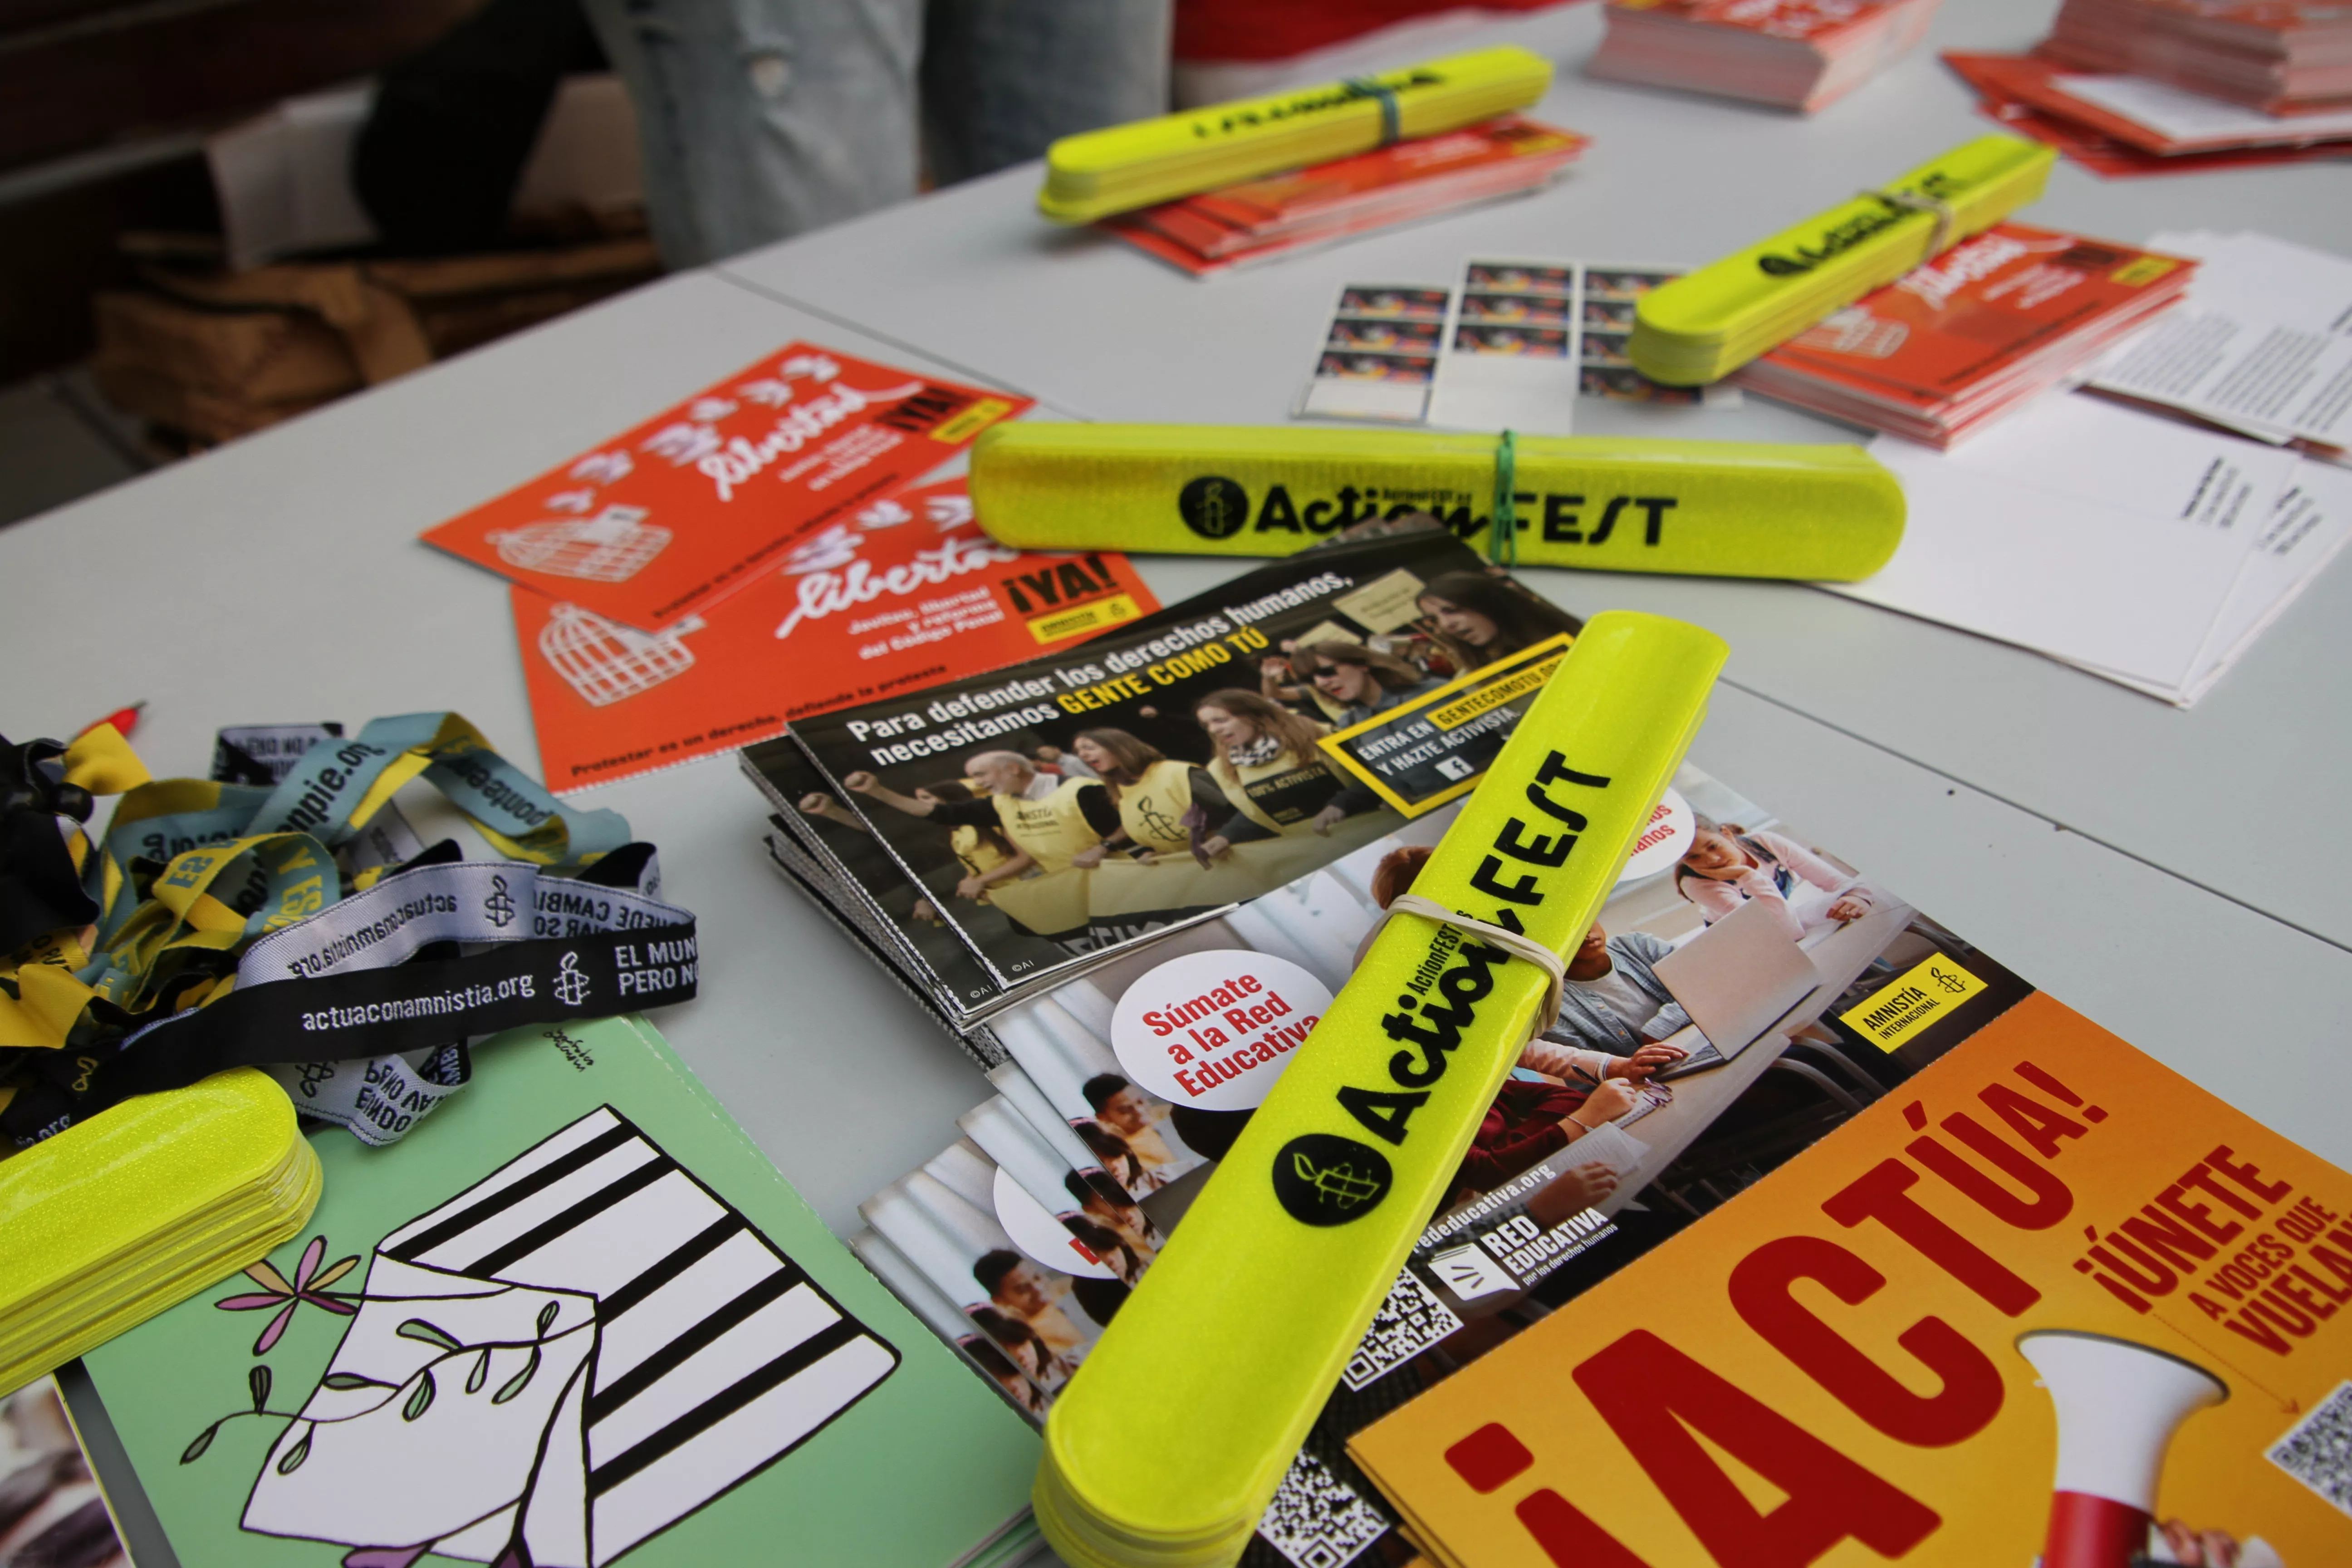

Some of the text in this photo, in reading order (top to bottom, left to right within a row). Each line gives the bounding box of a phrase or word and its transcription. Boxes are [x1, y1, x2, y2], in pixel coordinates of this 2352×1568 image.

[775, 536, 1021, 639] liberta
[1002, 555, 1118, 612] ¡YA!
[846, 711, 927, 743] Para
[926, 678, 1059, 723] defender
[1054, 658, 1105, 688] los
[1104, 615, 1232, 673] derechos
[1224, 573, 1355, 626] humanos,
[870, 624, 1271, 767] necesitamos GENTE COMO TÚ
[1357, 730, 1413, 762] ENTRA
[1406, 720, 1436, 743] EN
[1375, 707, 1522, 777] Y HAZTE ACTIVISTA.
[1630, 824, 1676, 858] anos
[614, 936, 697, 969] EL MUN
[618, 967, 677, 996] PERO
[302, 975, 536, 1031] actuaconamnistia.org
[1142, 974, 1264, 1037] Súmate
[1167, 990, 1294, 1065] a la Red
[1862, 986, 1928, 1032] AMNISTÍA
[1878, 998, 1941, 1040] INTERNACIONAL
[1411, 1163, 1557, 1255] rededucativa.org
[1480, 1215, 1540, 1259] RED
[1502, 1207, 1609, 1276] EDUCATIVA
[2072, 1144, 2294, 1316] ¡ÚNETE
[1522, 1223, 1619, 1287] por los derechos humanos
[2187, 1196, 2339, 1322] A VOCES QUE
[2223, 1210, 2352, 1357] VUELA
[1443, 1060, 2109, 1568] ¡ACTÚA!
